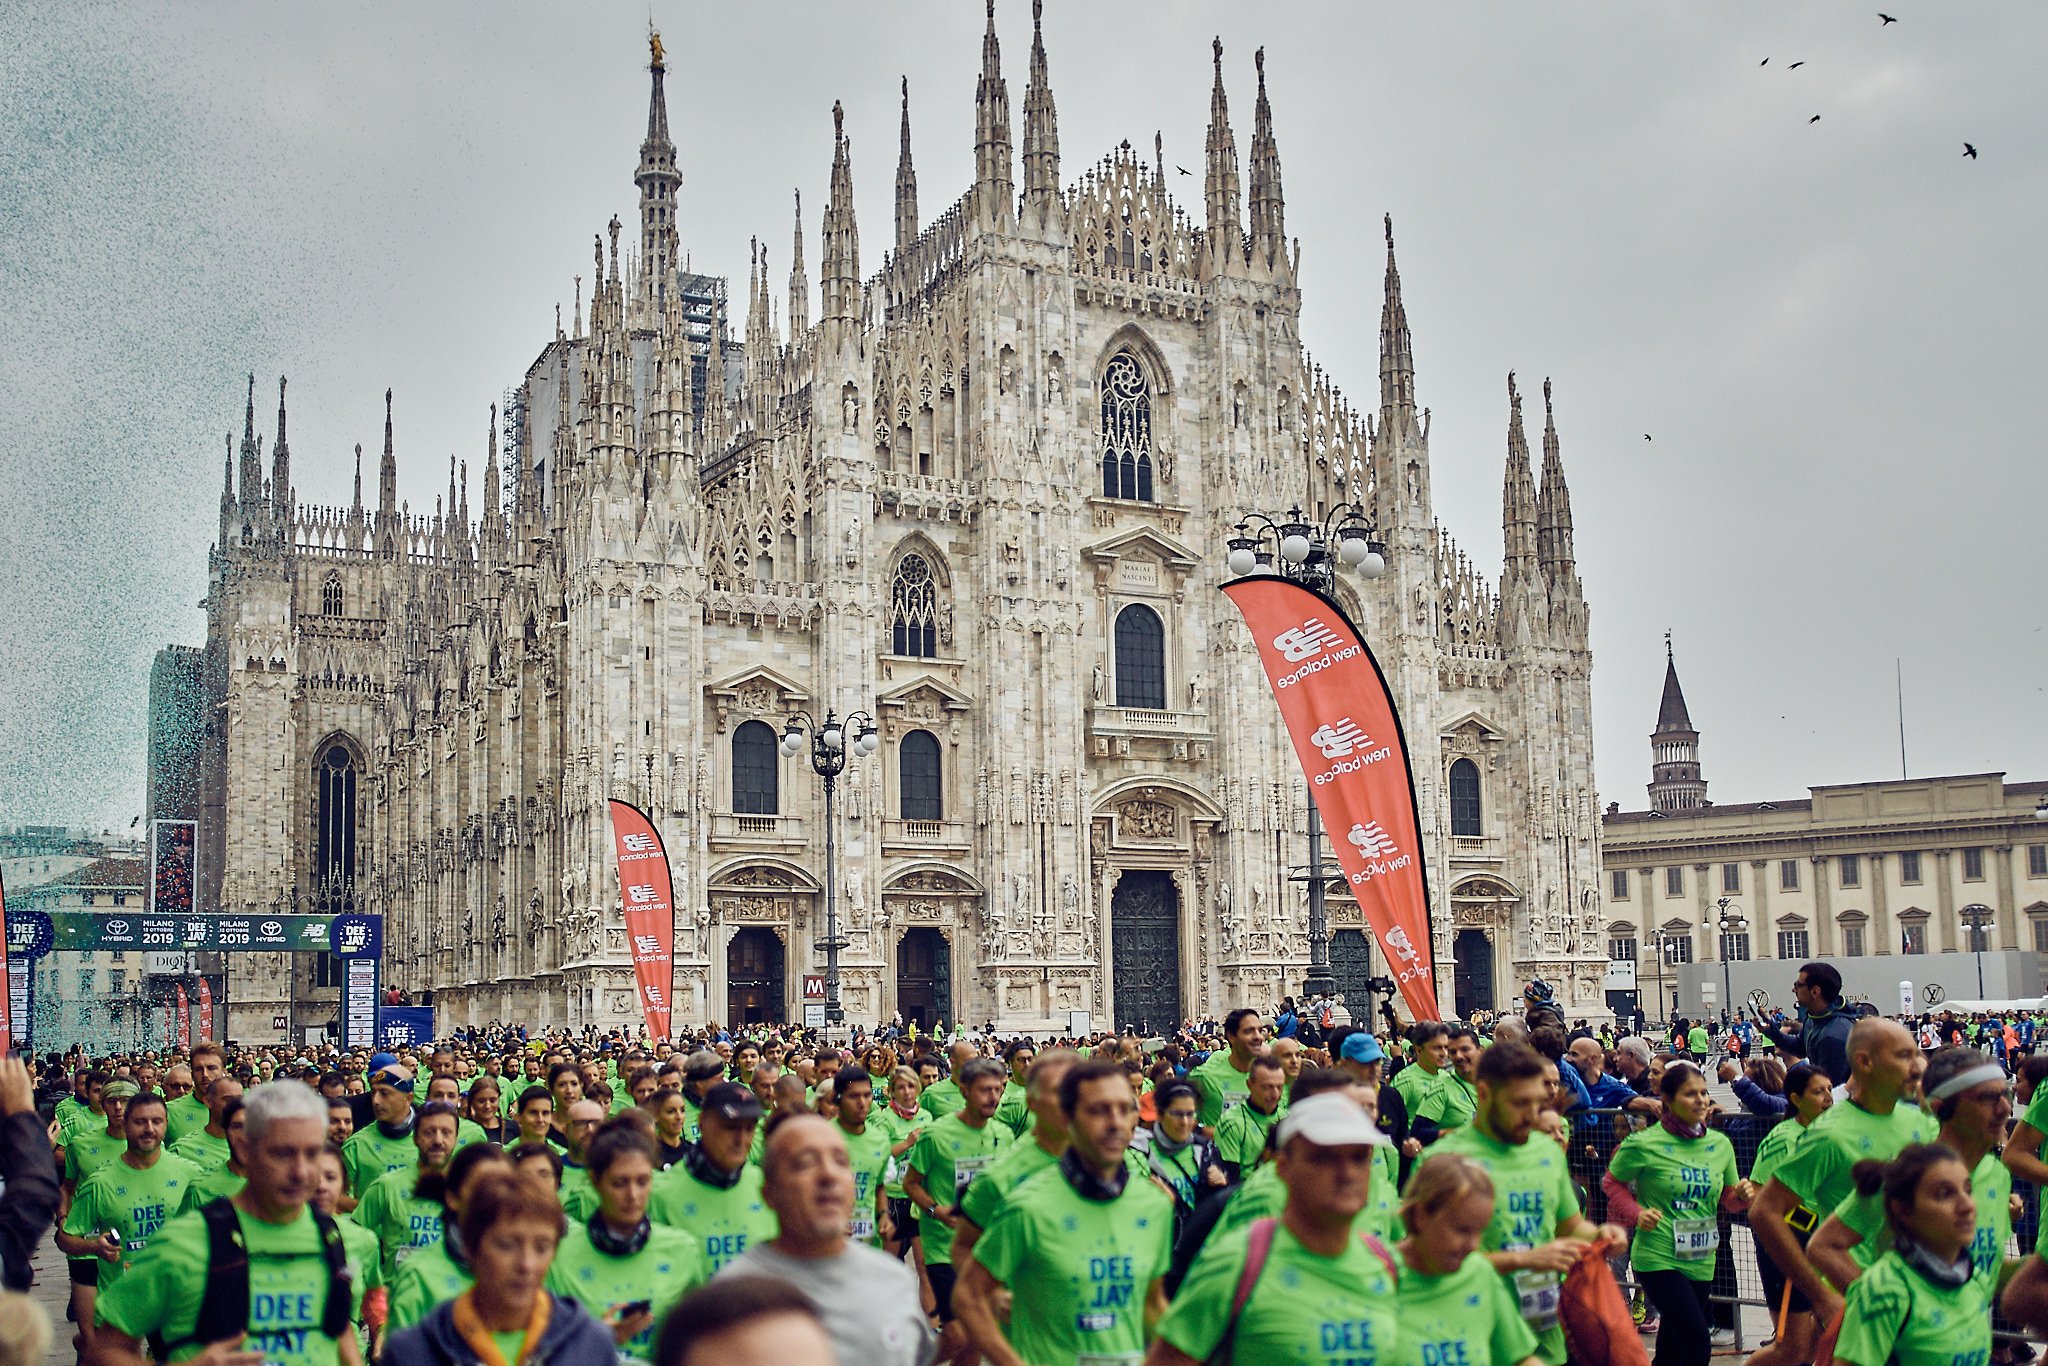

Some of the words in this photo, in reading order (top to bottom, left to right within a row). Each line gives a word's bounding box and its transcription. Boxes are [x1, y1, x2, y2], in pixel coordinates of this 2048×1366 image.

[1121, 574, 1154, 583] NASCENTI
[12, 923, 36, 934] DEE
[142, 920, 175, 928] MILANO
[187, 922, 207, 932] DEE
[345, 925, 366, 936] DEE
[12, 934, 36, 944] JAY
[142, 933, 174, 944] 2019
[187, 931, 206, 941] JAY
[218, 933, 250, 944] 2019
[345, 936, 366, 946] JAY
[806, 979, 824, 994] M
[274, 1018, 286, 1027] M
[387, 1026, 409, 1038] DEE
[855, 1172, 870, 1185] EE
[1681, 1167, 1711, 1183] DEE
[1681, 1184, 1712, 1199] JAY
[1509, 1191, 1544, 1213] DEE
[1674, 1200, 1697, 1209] TEN
[133, 1204, 166, 1222] DEE
[409, 1214, 442, 1231] DEE
[1512, 1215, 1544, 1237] JAY
[706, 1234, 747, 1257] DEE
[1090, 1256, 1134, 1281] DEE
[1090, 1283, 1134, 1308] JAY
[254, 1293, 314, 1322] DEE
[250, 1326, 308, 1355] JAY
[1321, 1320, 1376, 1352] DEE
[1422, 1340, 1470, 1366] DEE
